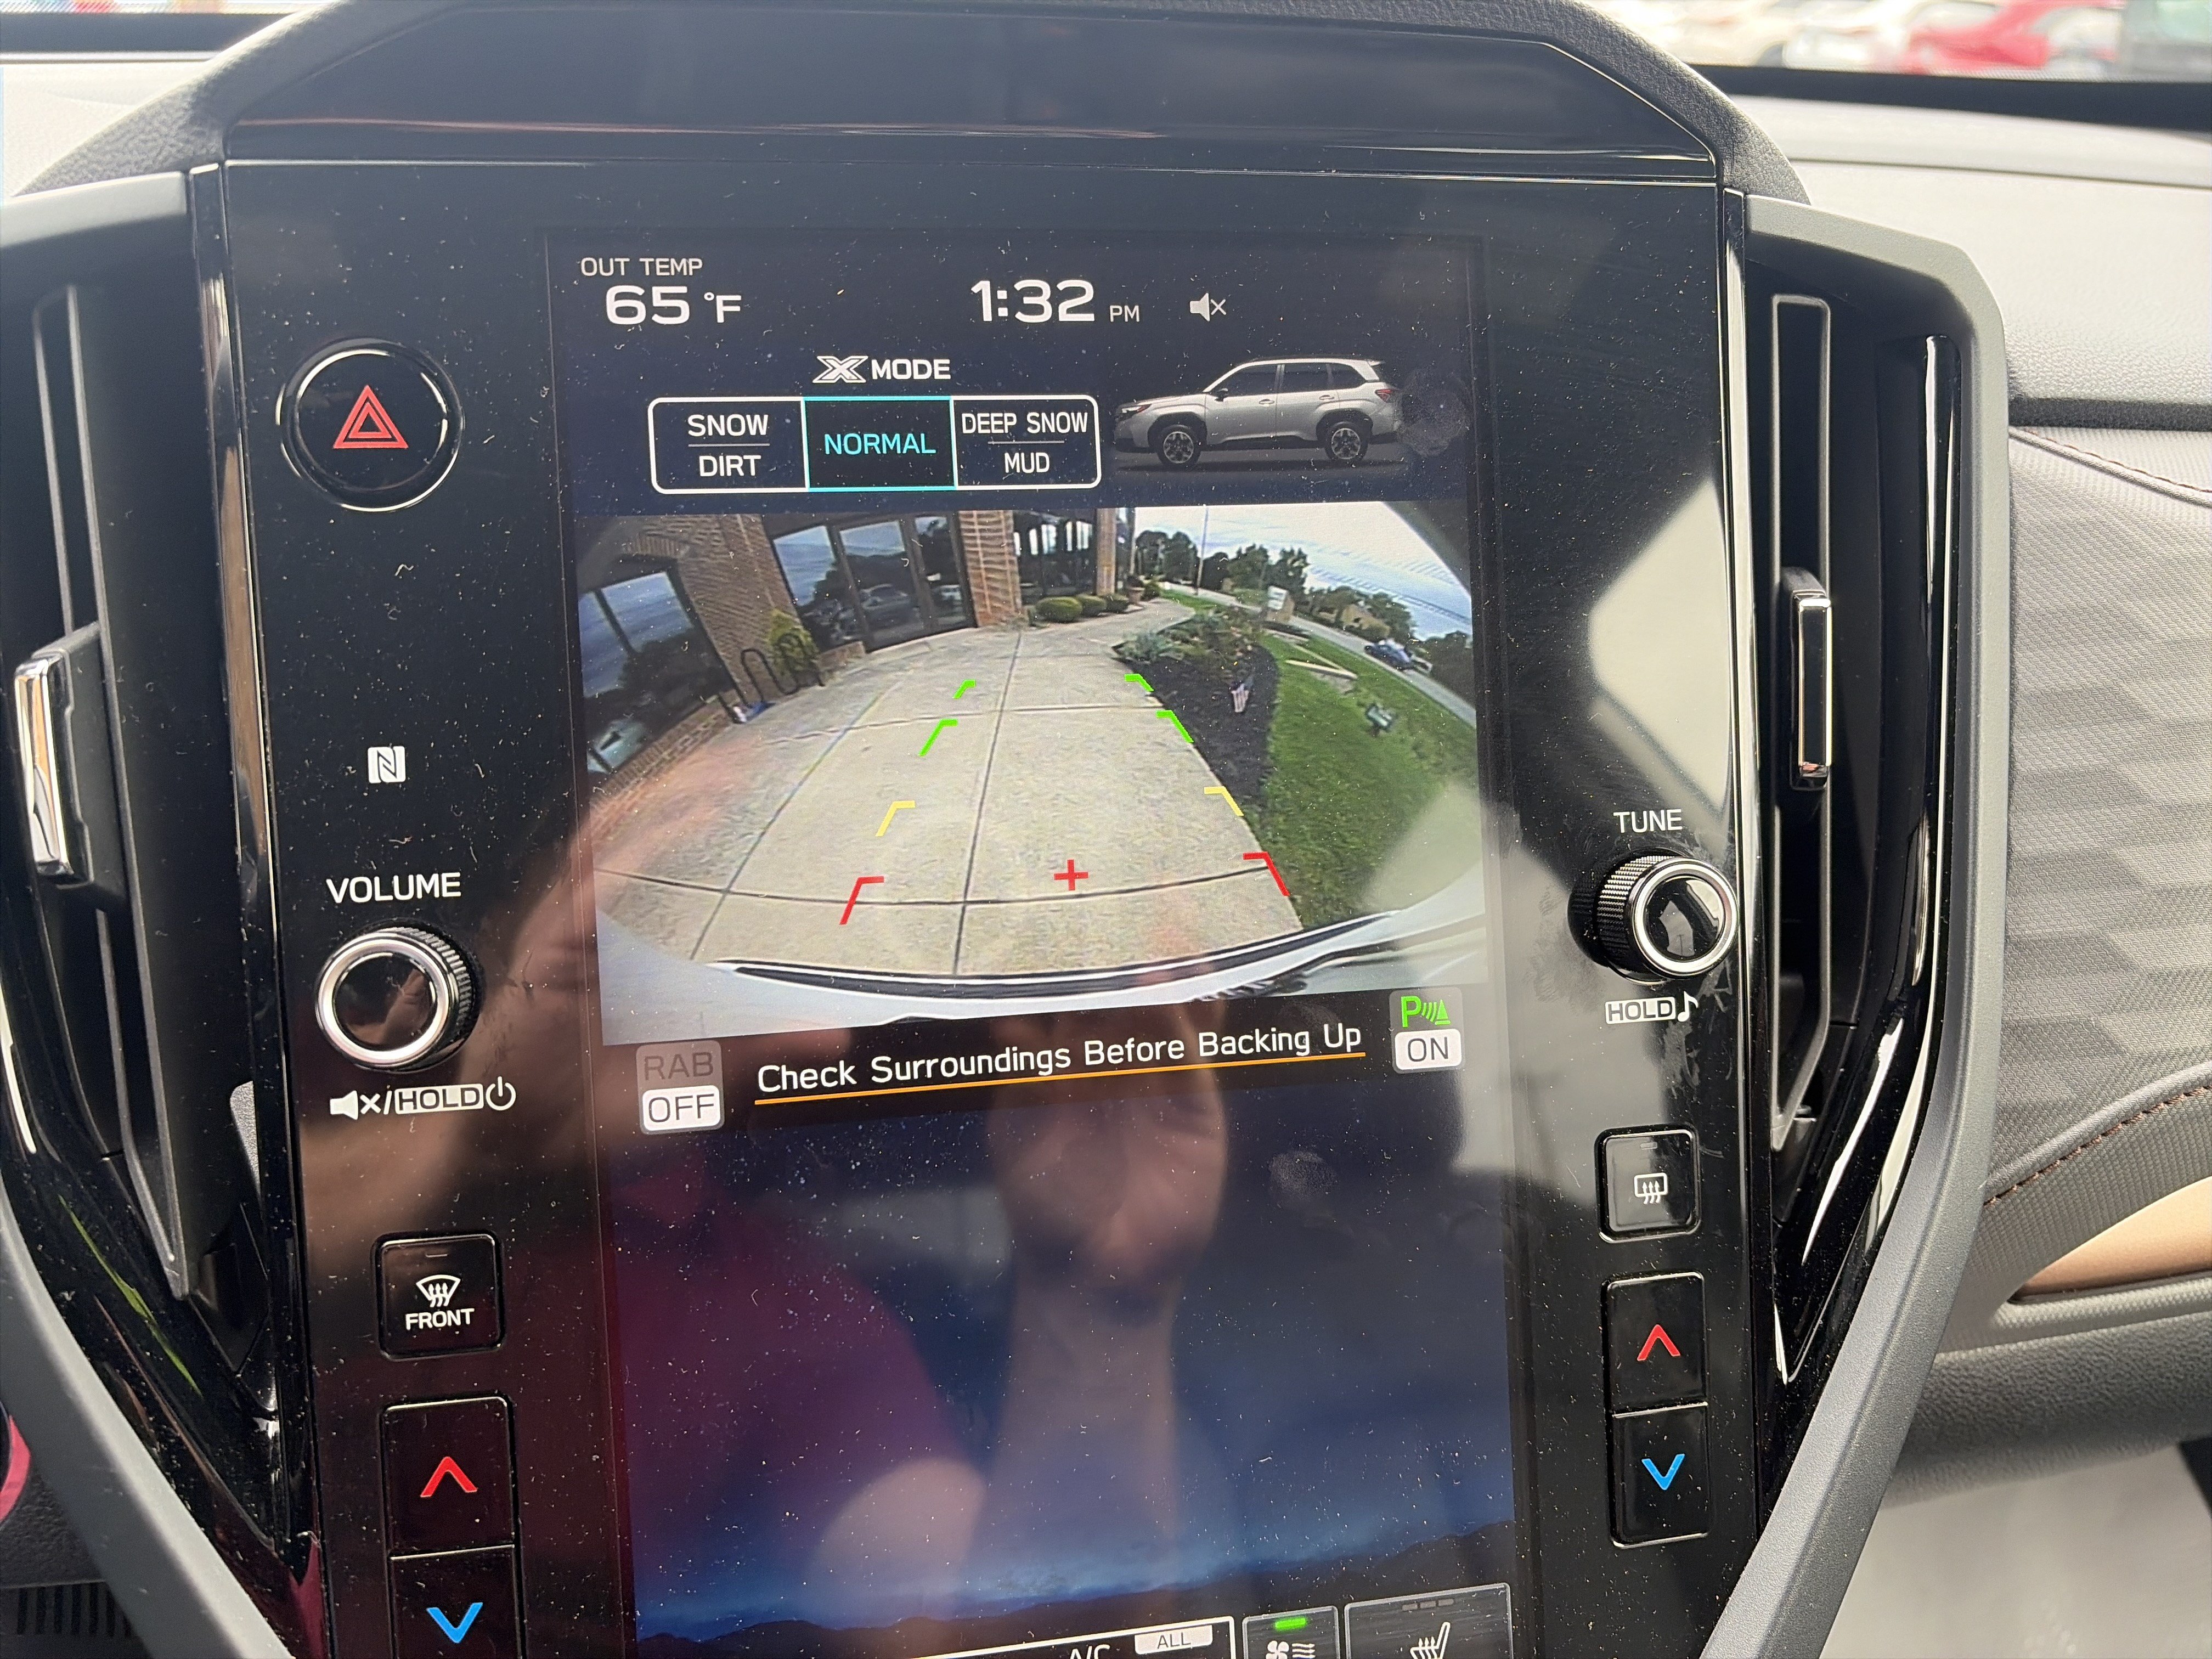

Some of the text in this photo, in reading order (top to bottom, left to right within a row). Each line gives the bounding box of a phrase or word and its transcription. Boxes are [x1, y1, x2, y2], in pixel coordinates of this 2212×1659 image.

[580, 257, 703, 276] OUT TEMP
[605, 285, 691, 325] 65
[970, 279, 1096, 323] 1:32
[1109, 305, 1141, 323] PM
[871, 359, 952, 380] MODE
[687, 414, 770, 437] SNOW
[961, 412, 1088, 435] DEEP SNOW
[824, 433, 936, 455] NORMAL
[698, 454, 761, 477] DIRT
[1003, 453, 1051, 473] MUD
[1613, 809, 1683, 833] TUNE
[326, 872, 462, 904] VOLUME
[1607, 999, 1673, 1023] HOLD
[758, 1023, 1362, 1093] Check Surroundings Before Backing Up
[1407, 1036, 1449, 1063] ON
[644, 1052, 714, 1081] RAB
[648, 1093, 715, 1123] OFF
[405, 1307, 475, 1331] FRONT
[1157, 1632, 1192, 1650] ALL
